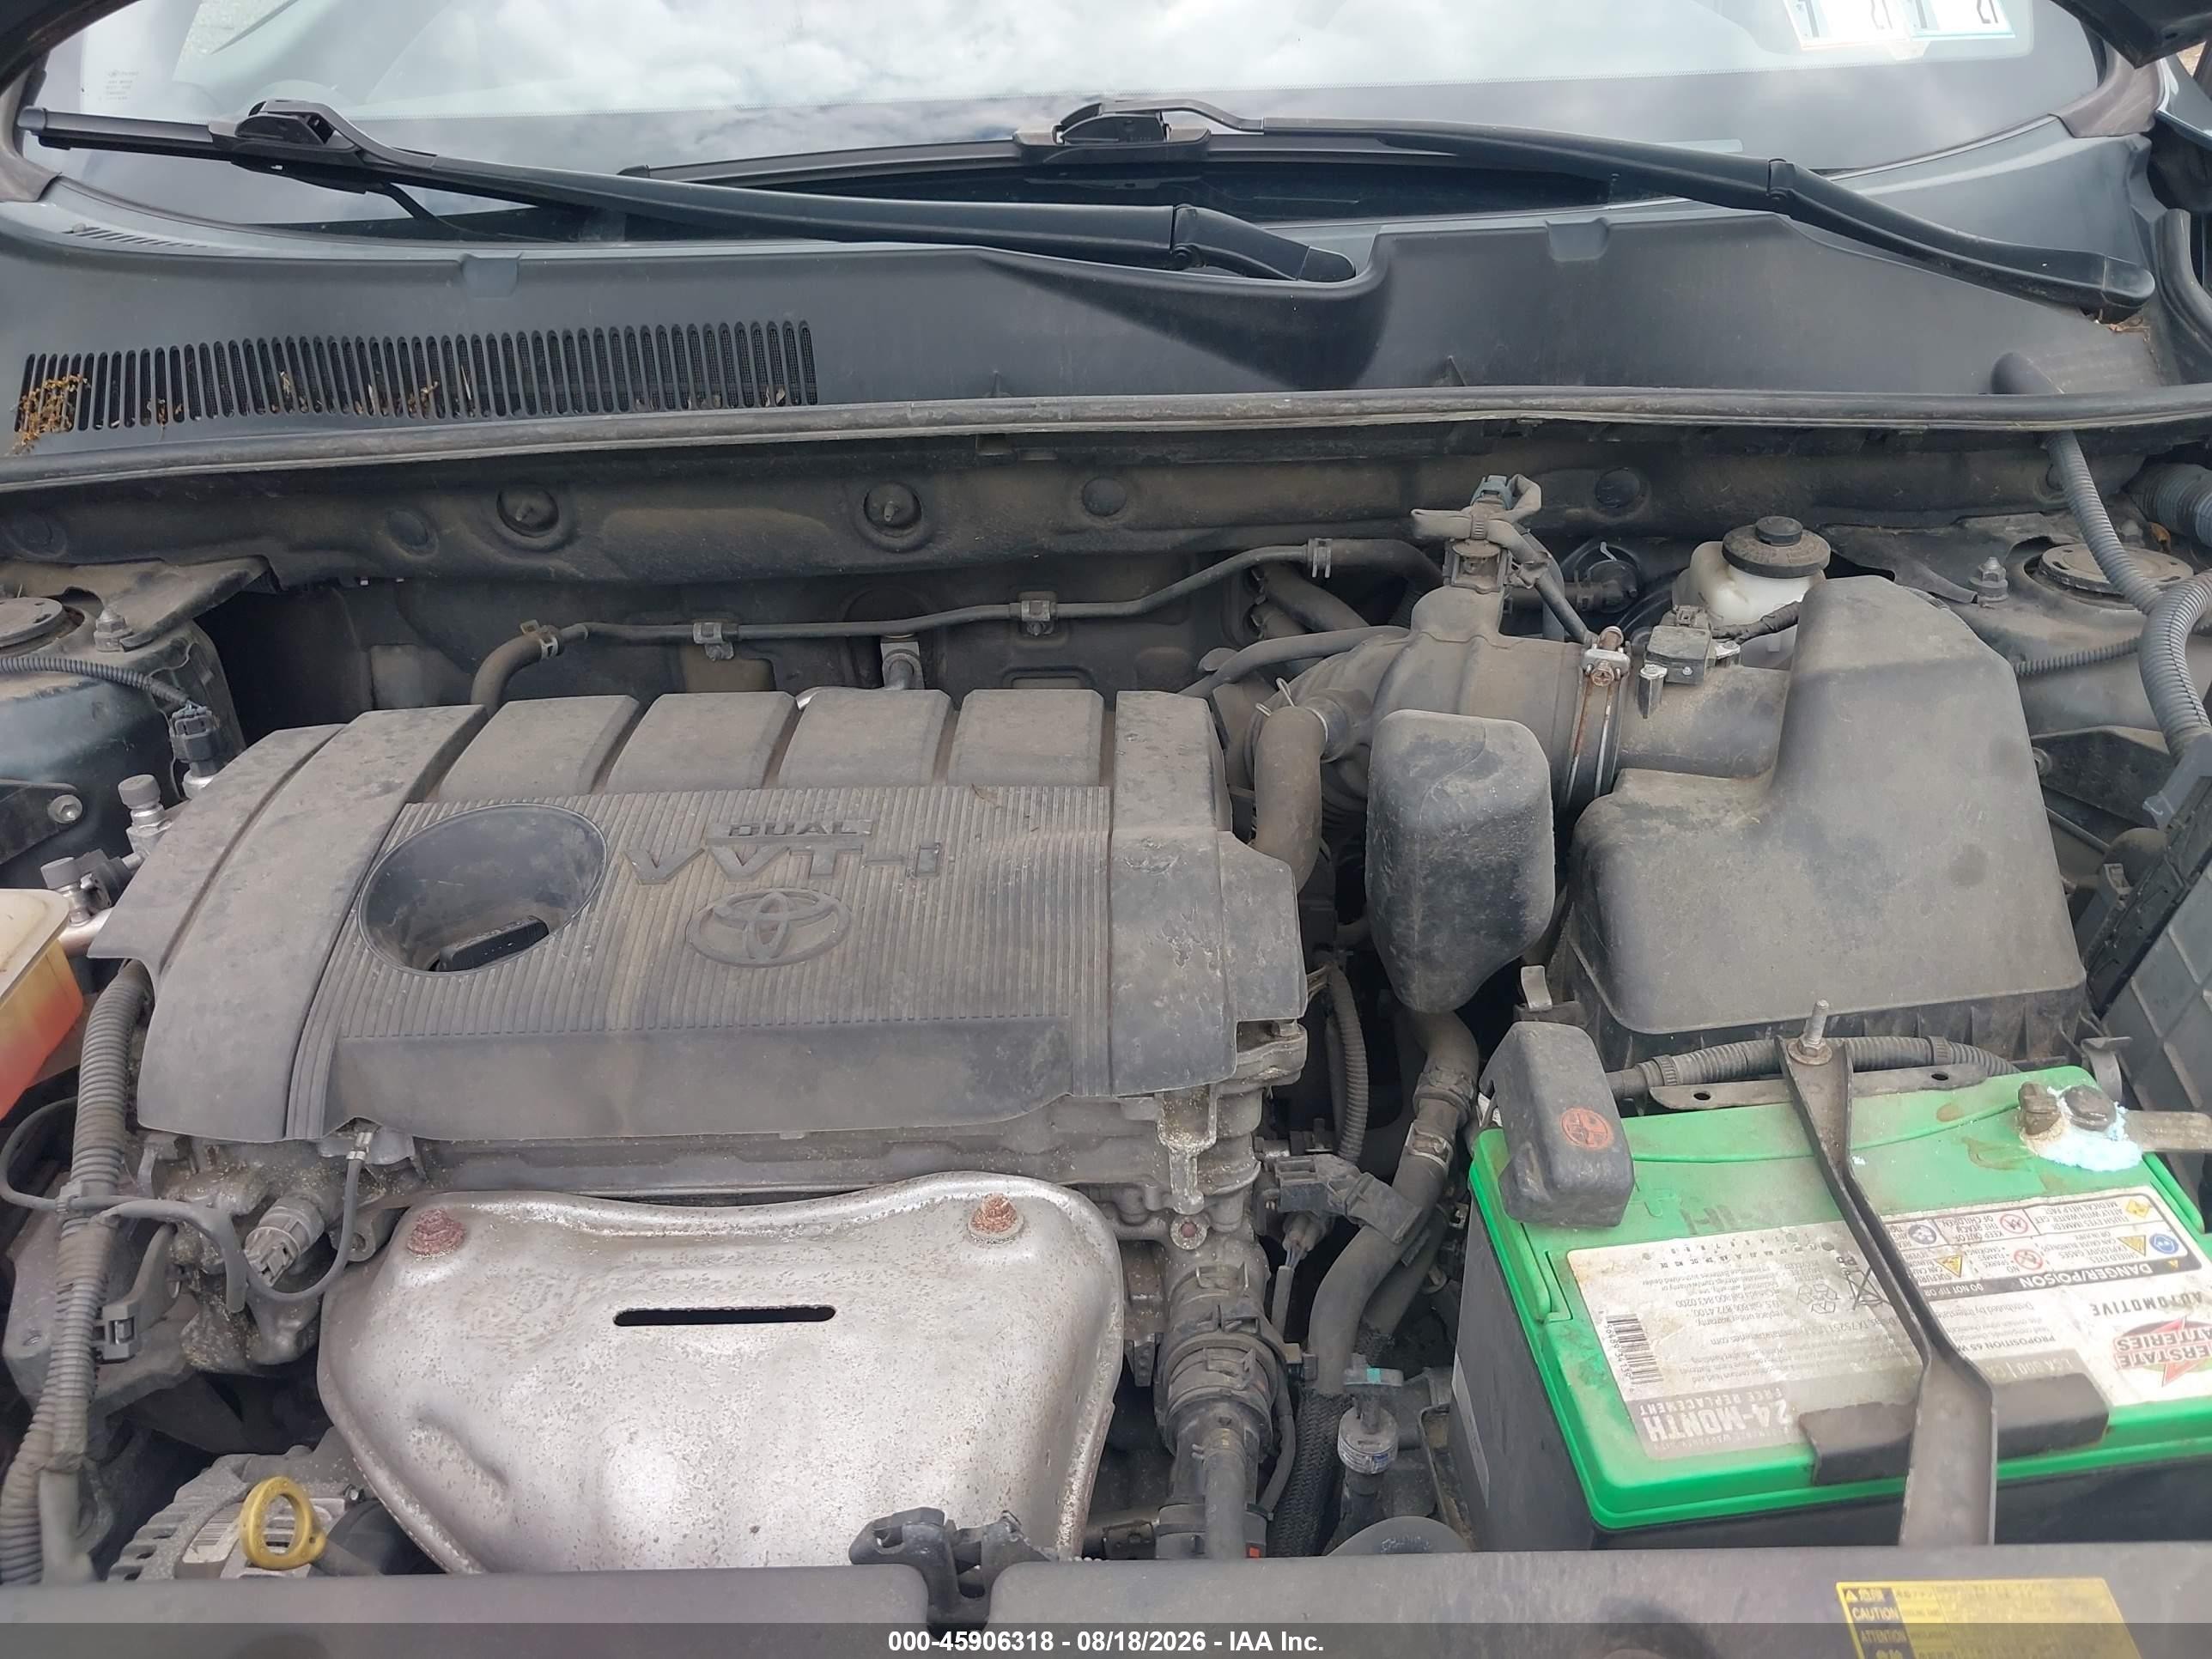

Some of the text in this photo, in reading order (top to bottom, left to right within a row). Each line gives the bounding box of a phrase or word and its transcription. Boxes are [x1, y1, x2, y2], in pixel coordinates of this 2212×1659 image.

[728, 823, 858, 837] DUAL
[2018, 1262, 2154, 1289] DANGER/POISON
[1936, 1287, 1952, 1296] TIP
[1953, 1285, 1970, 1294] NOT
[2089, 1291, 2203, 1317] AUTOMOTIVE
[1970, 1342, 1984, 1352] 65
[1985, 1335, 2057, 1351] PROPOSITION
[2117, 1328, 2212, 1352] ATTERIES
[2117, 1345, 2209, 1369] ERSTATE
[1639, 1394, 1741, 1416] REPLACEMENT
[1642, 1400, 1793, 1443] 24-MONTH
[1851, 1607, 1900, 1621] CAUTION
